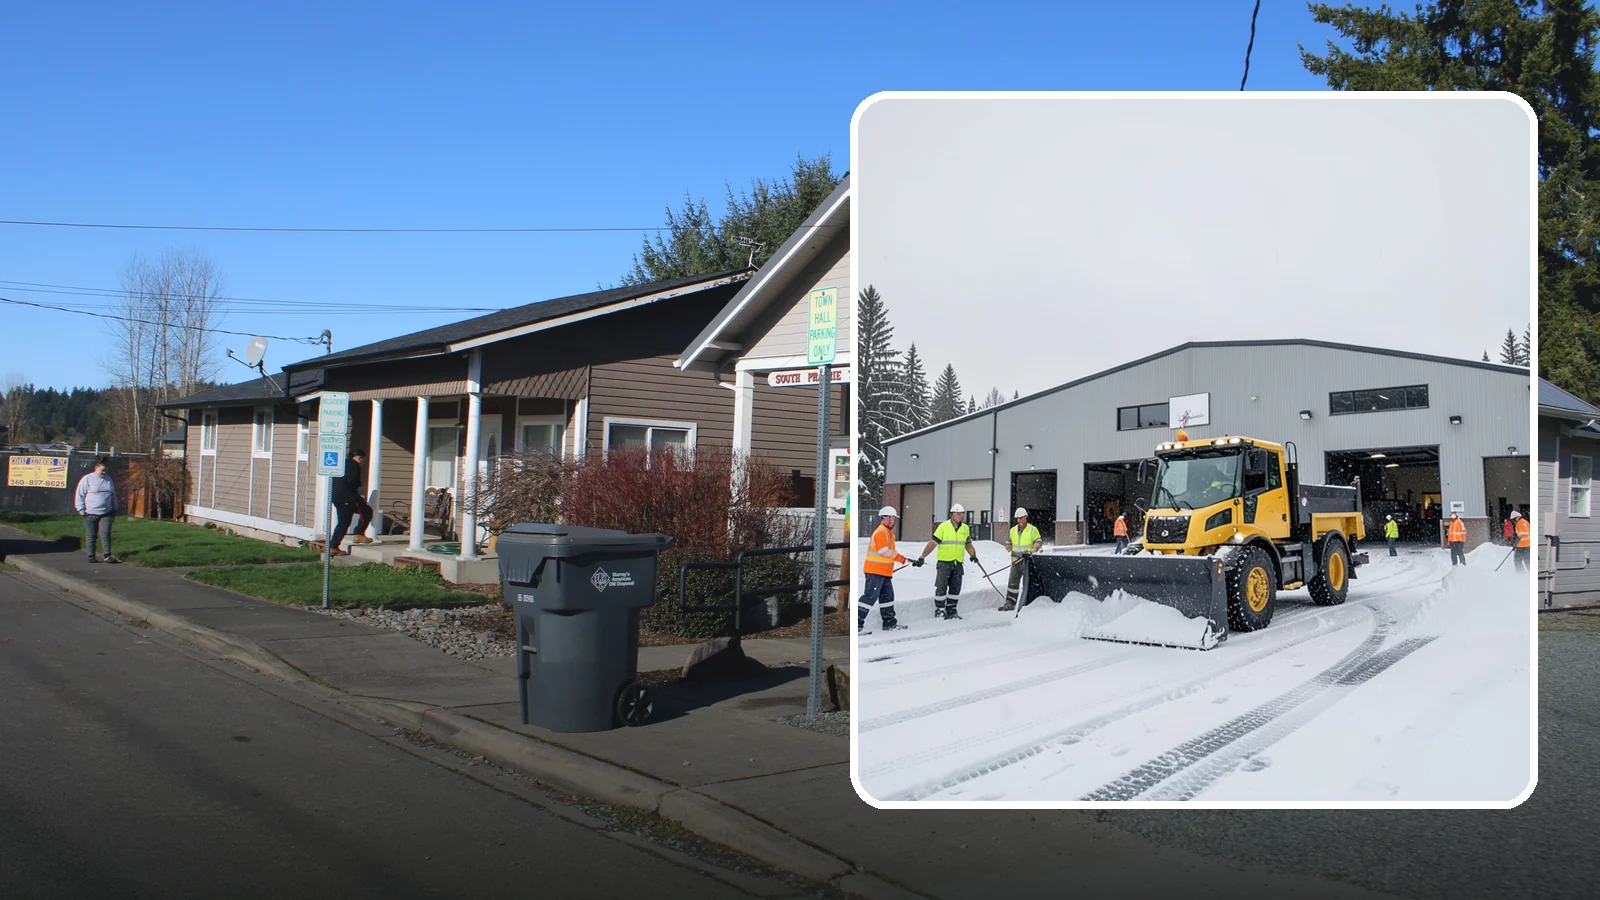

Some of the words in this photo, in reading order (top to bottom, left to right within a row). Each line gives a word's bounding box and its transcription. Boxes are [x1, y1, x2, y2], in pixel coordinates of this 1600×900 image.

[815, 294, 833, 308] TOWN
[815, 311, 831, 325] HALL
[810, 326, 836, 341] PARKING
[814, 344, 831, 357] ONLY
[775, 373, 801, 384] SOUTH
[322, 409, 345, 417] PARKING
[325, 420, 340, 428] ONLY
